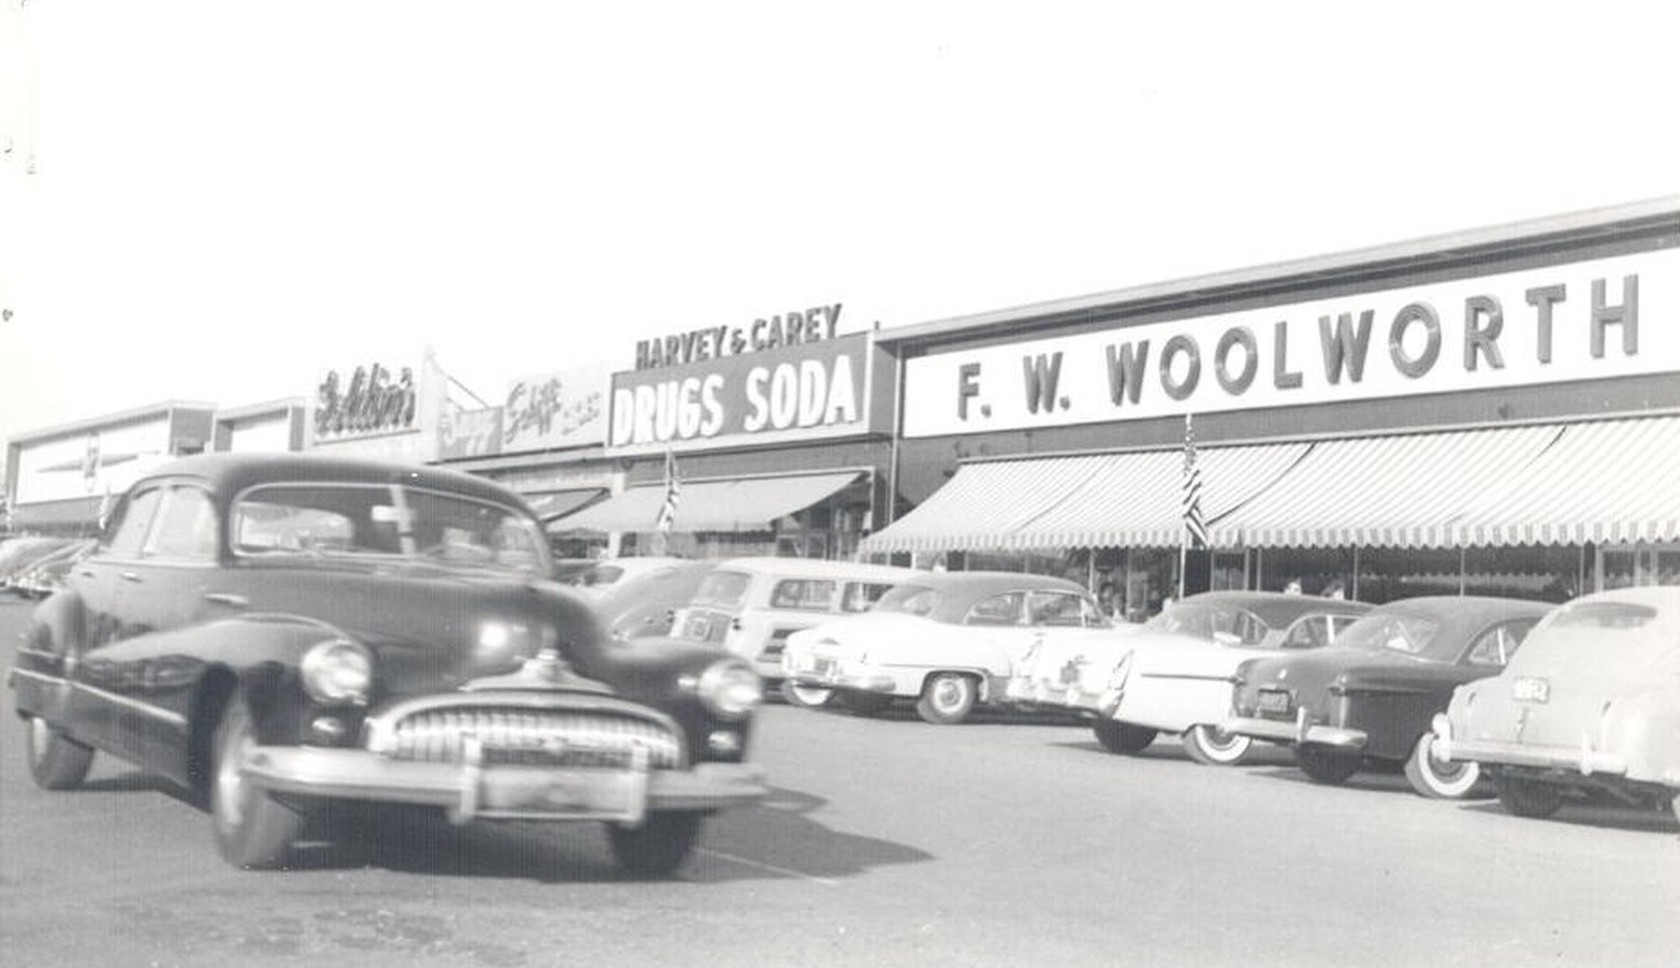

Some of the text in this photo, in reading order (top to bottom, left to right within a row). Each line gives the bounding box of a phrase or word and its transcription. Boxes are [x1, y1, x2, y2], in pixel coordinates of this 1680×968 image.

[635, 303, 842, 370] HARVEY & CAREY
[957, 273, 1640, 421] F. W. WOOLWORTH
[612, 373, 725, 447] DRUGS
[743, 354, 857, 433] SODA
